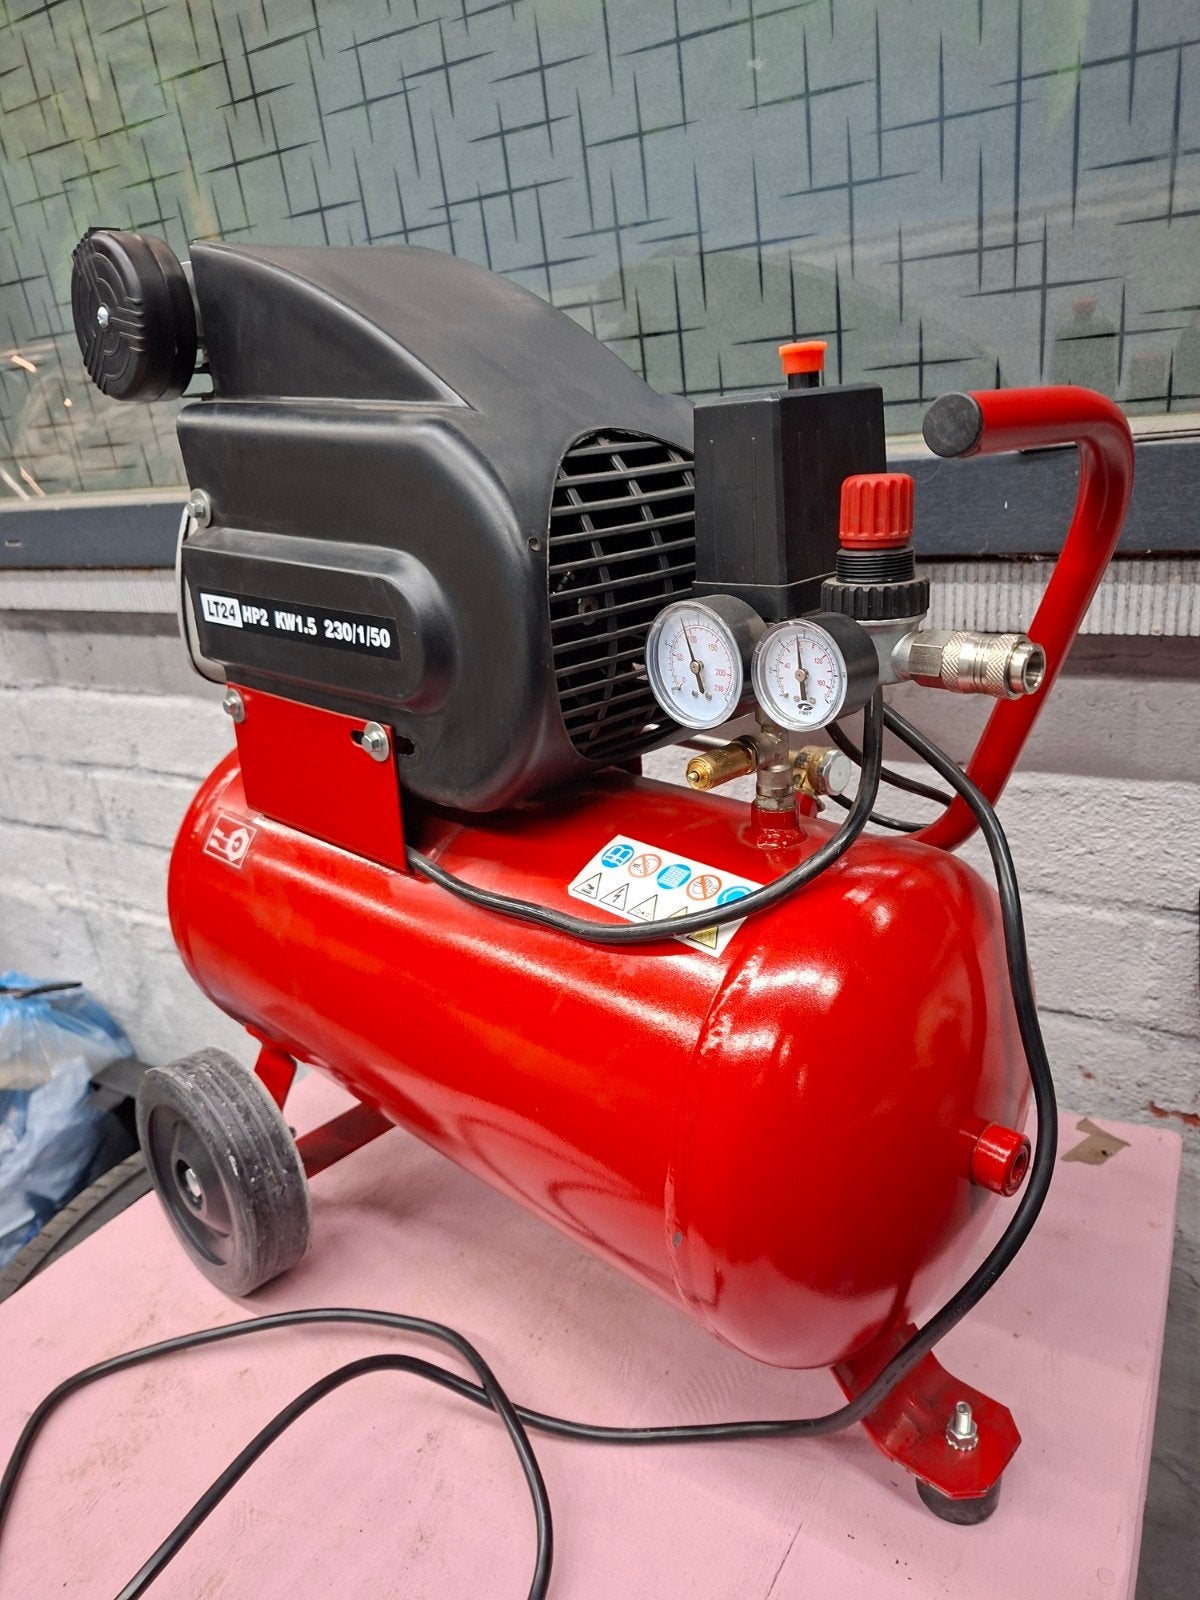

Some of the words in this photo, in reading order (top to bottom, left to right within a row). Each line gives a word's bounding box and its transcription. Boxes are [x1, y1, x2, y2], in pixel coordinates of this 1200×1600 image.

[207, 599, 237, 622] LT24
[241, 604, 269, 627] HP2
[274, 610, 318, 636] KW1.5
[323, 619, 391, 649] 230/1/50
[708, 643, 718, 652] 150
[715, 669, 726, 677] 200
